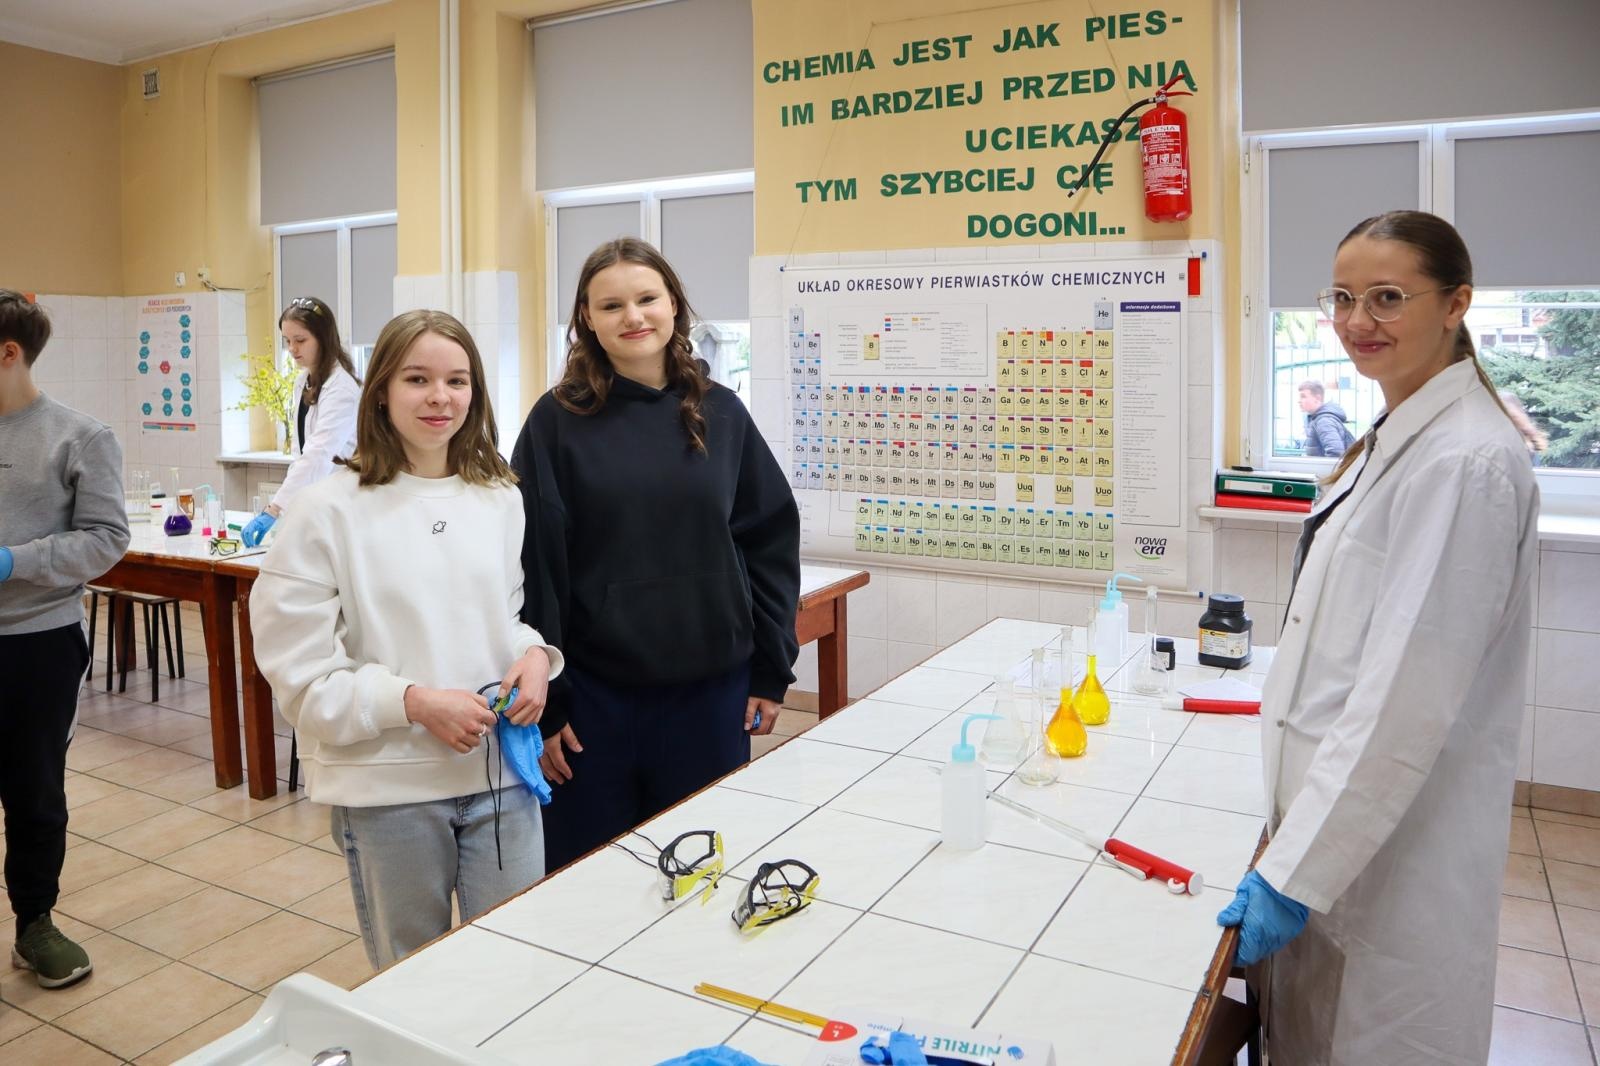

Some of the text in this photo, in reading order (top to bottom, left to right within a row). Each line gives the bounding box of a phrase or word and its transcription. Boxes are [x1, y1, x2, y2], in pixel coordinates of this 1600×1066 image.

[763, 10, 1183, 83] CHEMIA JEST JAK PIES-
[781, 60, 1198, 127] IM BARDZIEJ PRZED NIĄ
[966, 116, 1141, 153] UCIEKASZ
[796, 178, 857, 204] TYM
[880, 167, 1034, 197] SZYBCIEJ
[1057, 163, 1113, 194] CIĘ
[967, 212, 1125, 238] DOGONI...
[798, 271, 1165, 293] UKŁAD OKRESOWY PIERWIASTKÓW CHEMICZNYCH
[1017, 484, 1032, 492] Uuq
[1135, 536, 1167, 546] nowa
[1142, 545, 1166, 556] era
[932, 1037, 1002, 1057] NITRILE
